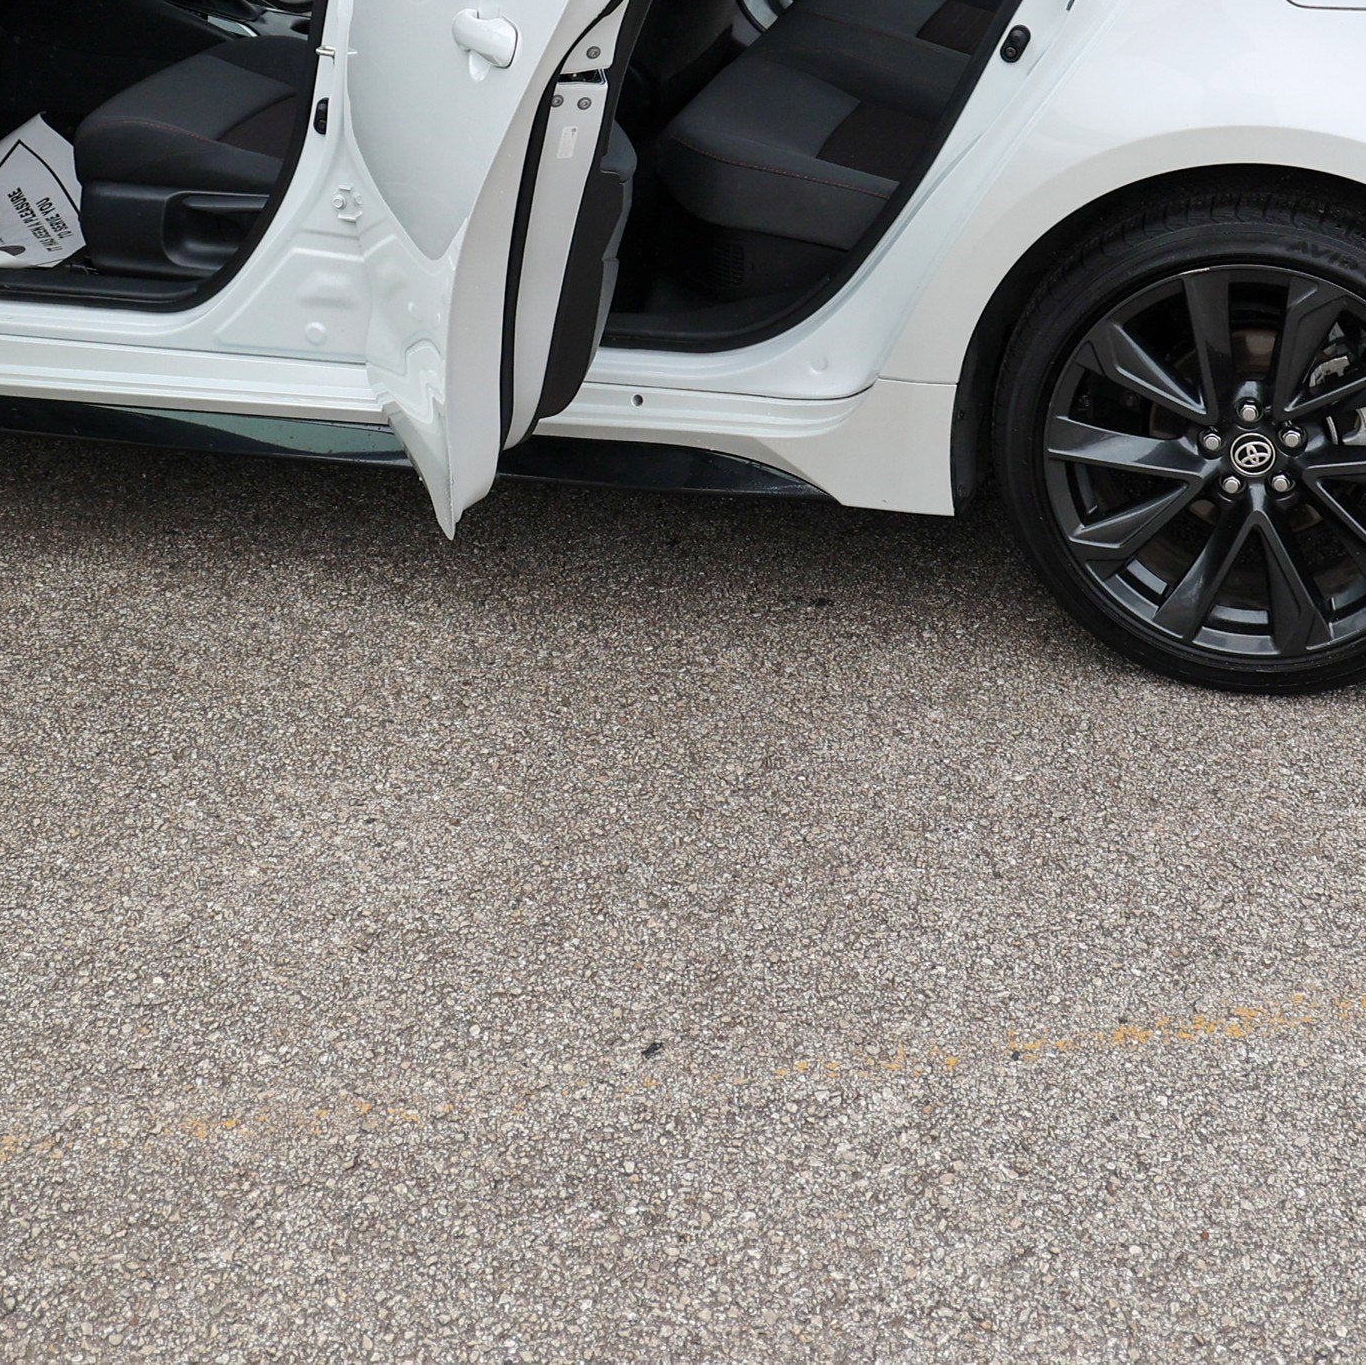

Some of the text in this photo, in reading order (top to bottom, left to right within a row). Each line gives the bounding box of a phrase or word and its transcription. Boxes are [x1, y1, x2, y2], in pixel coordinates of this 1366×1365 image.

[7, 187, 39, 224] PLEASURE
[35, 197, 55, 216] YOU
[45, 213, 68, 233] SERVE
